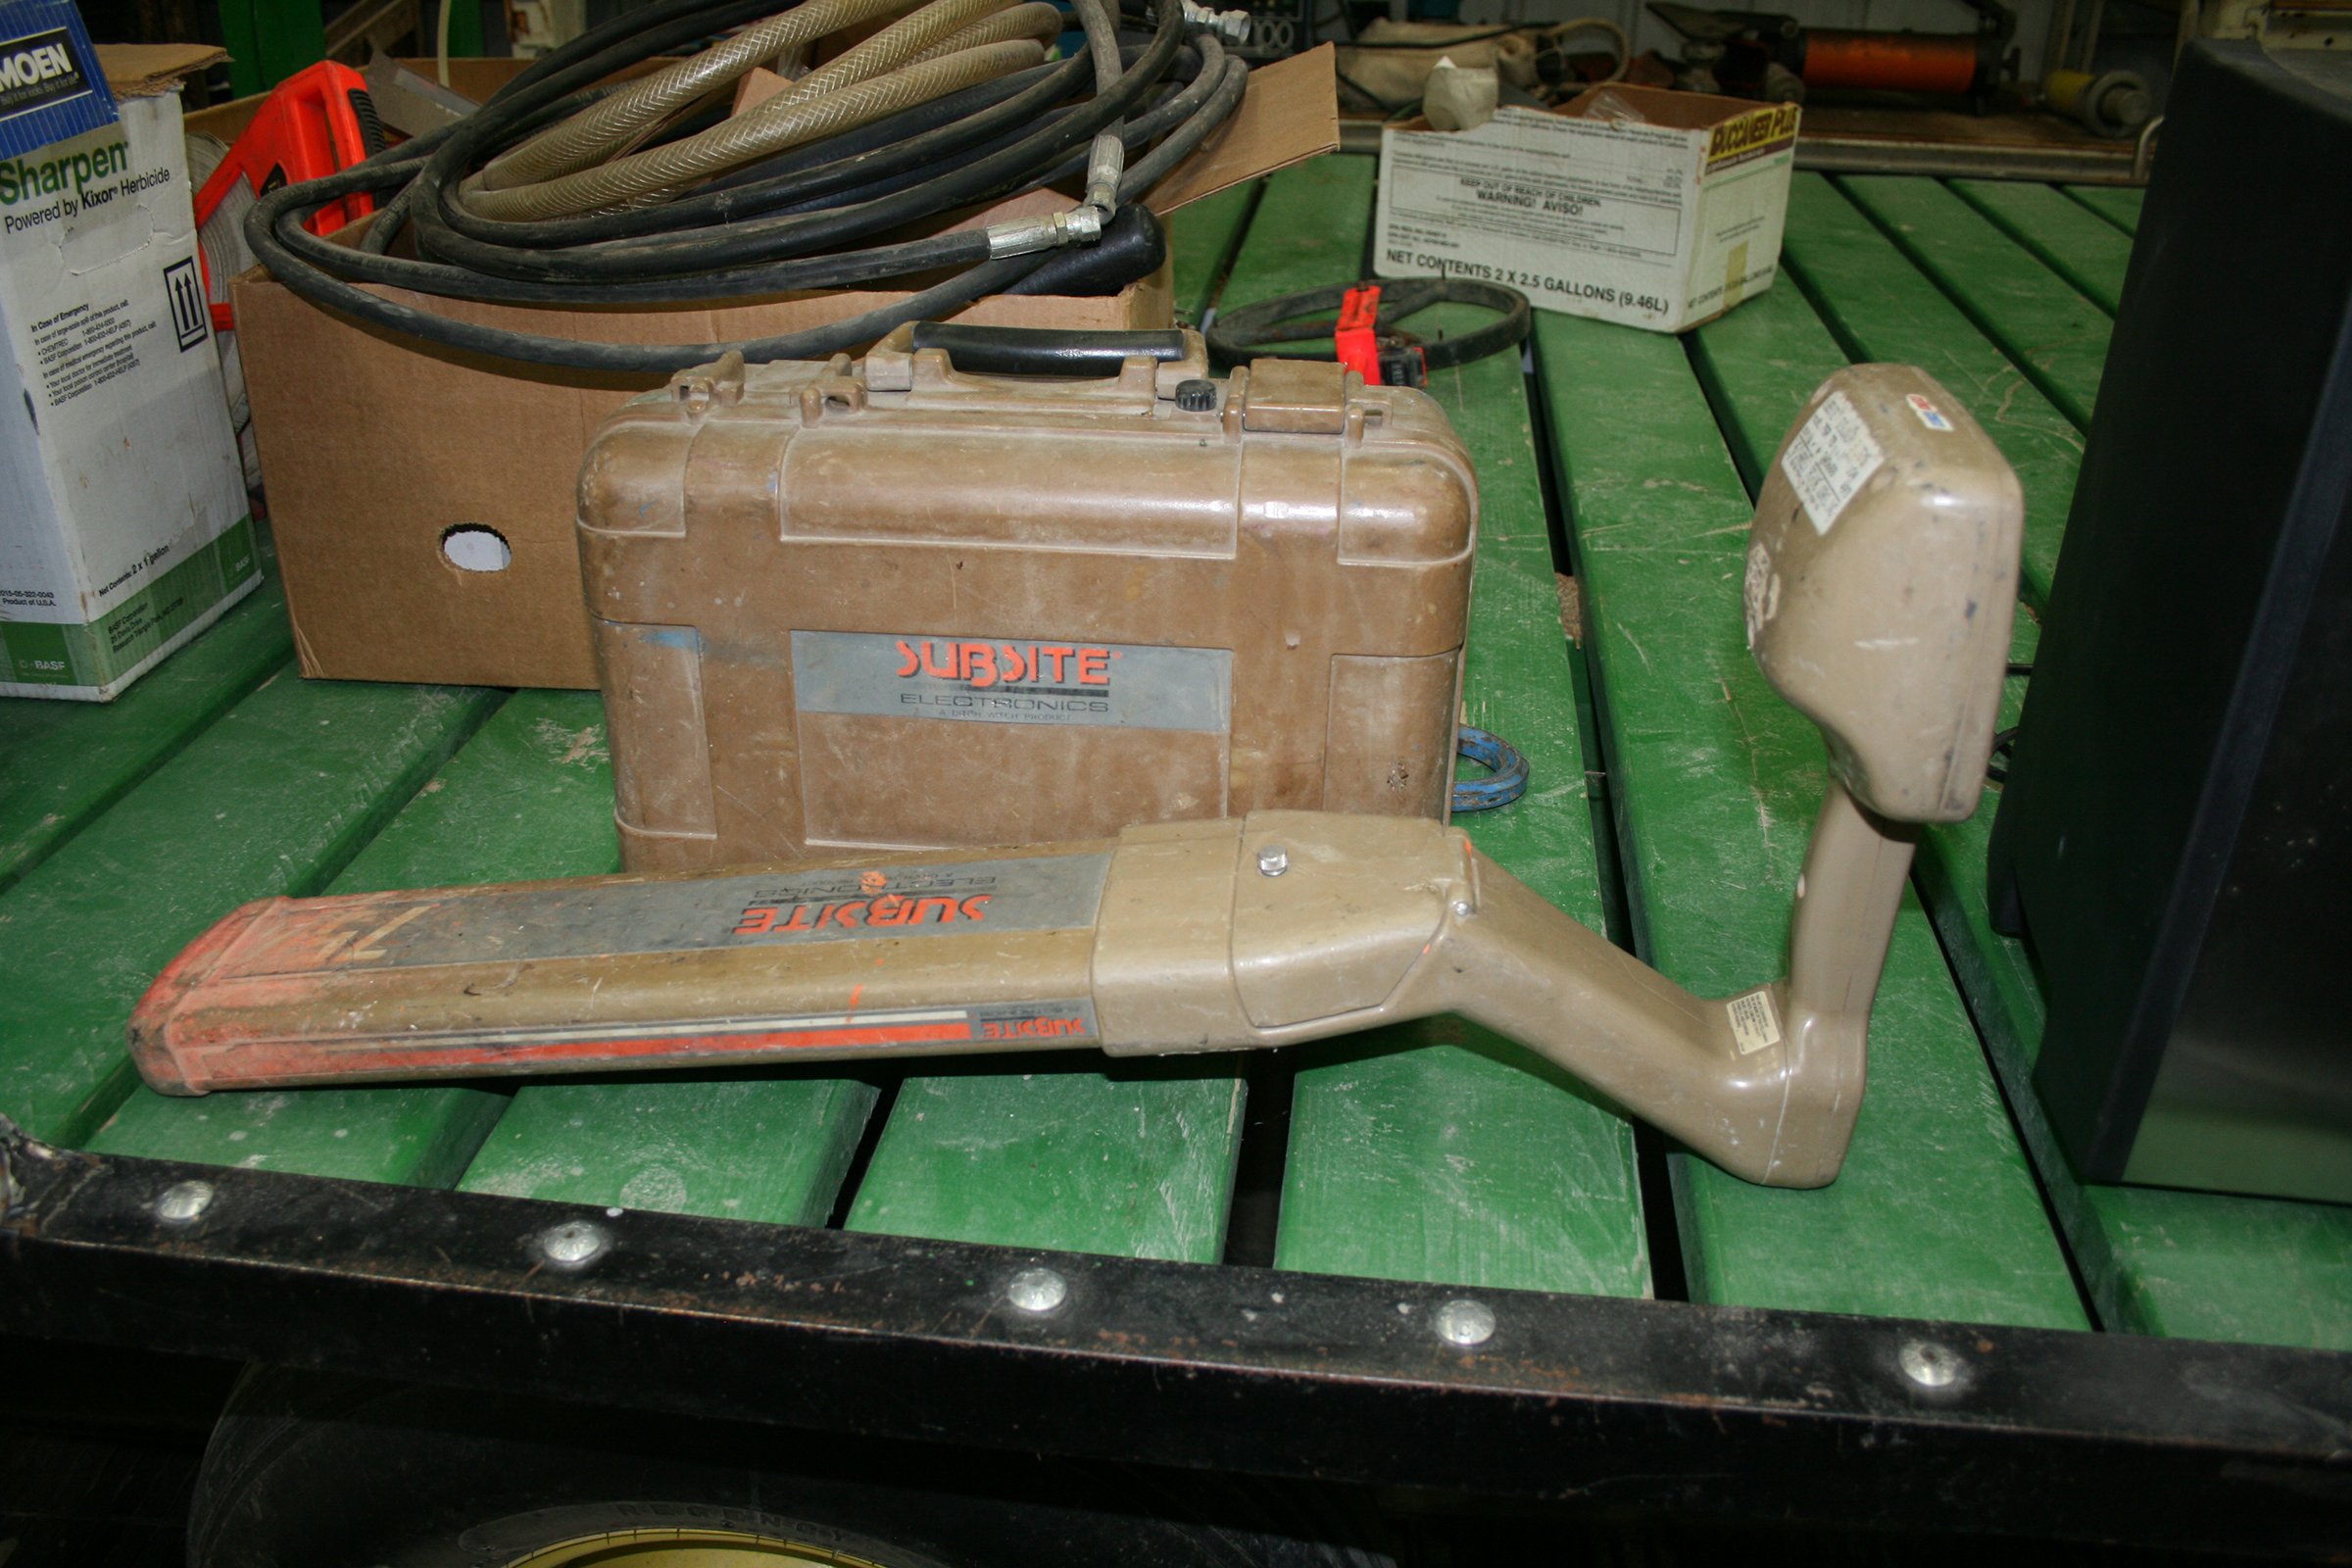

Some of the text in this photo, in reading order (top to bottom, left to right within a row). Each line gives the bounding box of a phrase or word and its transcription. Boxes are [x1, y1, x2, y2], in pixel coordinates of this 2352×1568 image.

[0, 43, 73, 92] MOEN
[0, 143, 127, 205] Sharpen
[1460, 177, 1481, 188] KEEP
[1483, 180, 1499, 190] OUT
[1503, 183, 1513, 193] OF
[1515, 185, 1543, 198] REACH
[1545, 189, 1556, 200] OF
[5, 202, 61, 234] Powered
[64, 198, 78, 218] by
[121, 167, 171, 197] Herbicide
[1476, 190, 1537, 209] WARNING!
[1542, 200, 1584, 217] AVISO!
[1387, 249, 1669, 316] NET CONTENTS 2 X 2.5 GALLONS (9.46L)
[31, 303, 89, 333] In Case of Emergency
[99, 586, 110, 597] Net
[131, 564, 138, 575] 2
[137, 562, 143, 571] x
[149, 545, 171, 565] gallon
[34, 660, 66, 671] BASF
[896, 640, 1110, 687] SUBSITE
[901, 693, 1109, 712] ELECTRONICS
[731, 893, 994, 935] SUBSITE
[980, 1015, 1087, 1039] SUBSITE
